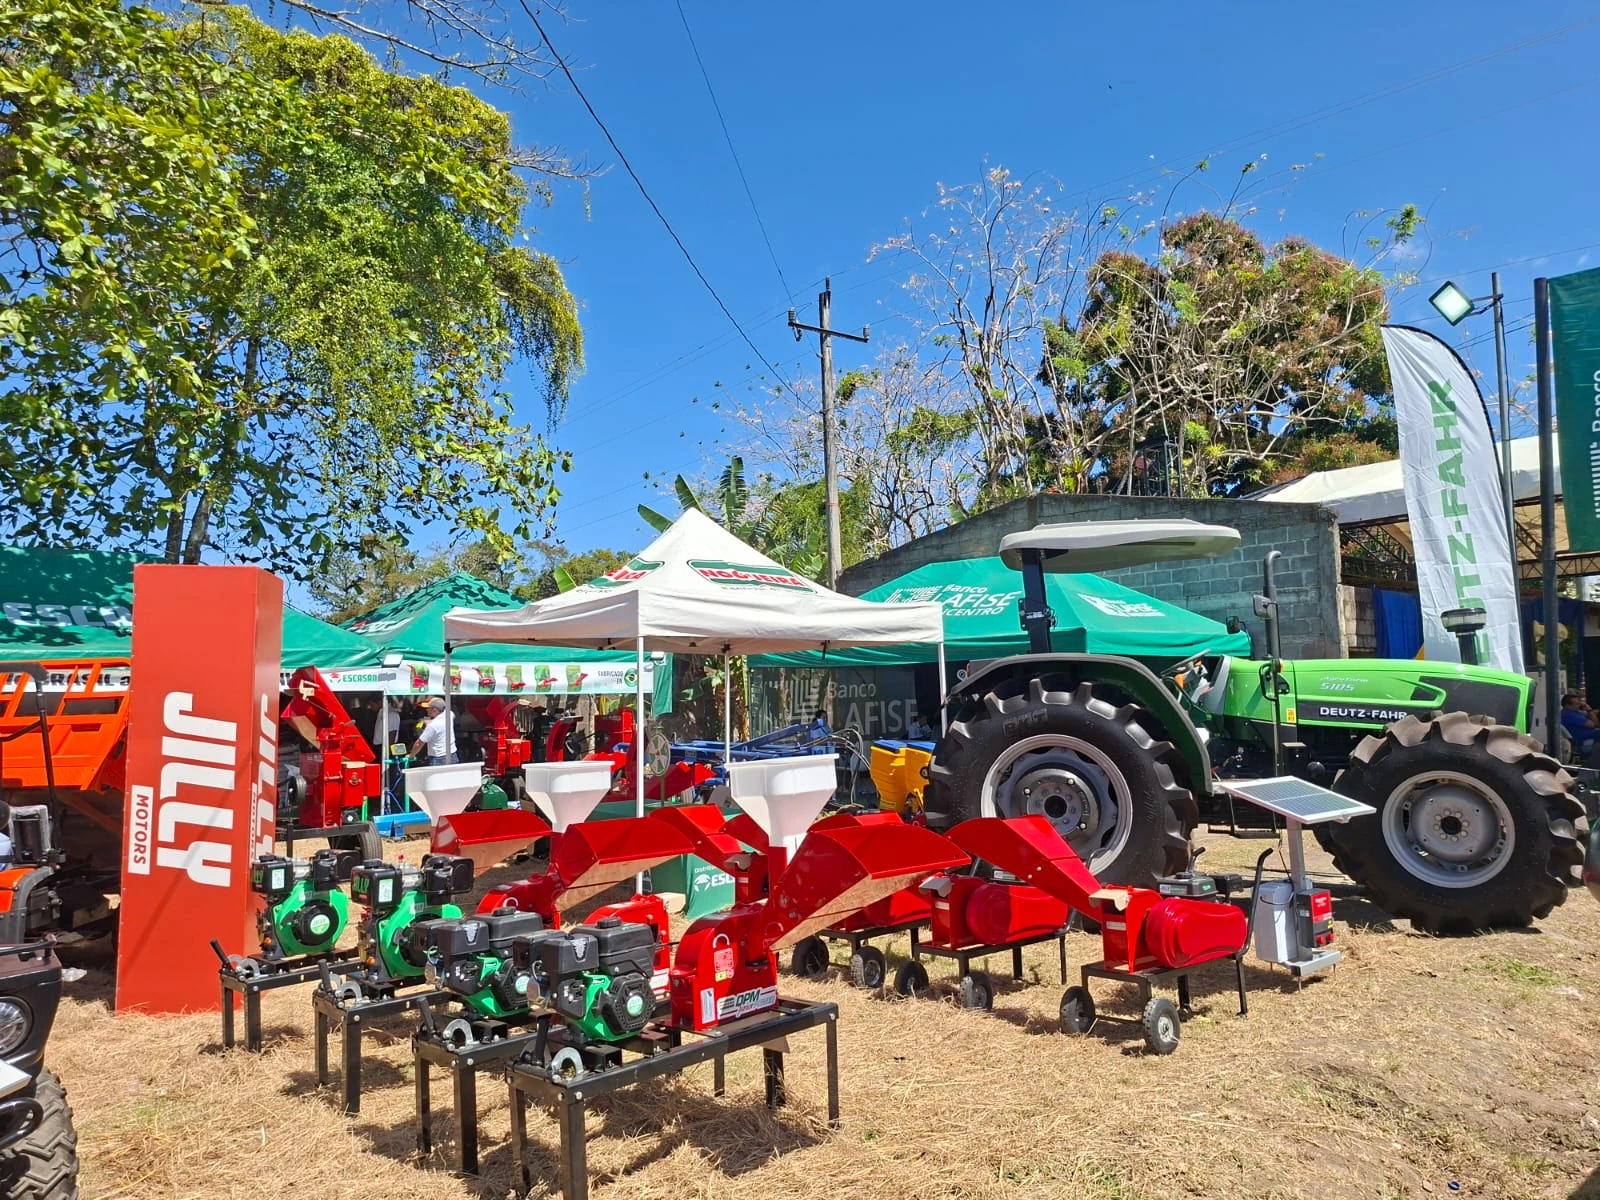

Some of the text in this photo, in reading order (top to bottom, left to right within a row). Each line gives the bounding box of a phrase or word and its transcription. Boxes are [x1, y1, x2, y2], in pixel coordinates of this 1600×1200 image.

[942, 584, 988, 594] Banco
[2, 602, 133, 627] ESCA
[828, 681, 877, 699] Banco
[1319, 706, 1407, 719] DEUTZ-FAHR
[156, 691, 237, 887] JILLY
[133, 793, 149, 865] MOTORS
[735, 989, 761, 1007] DPM
